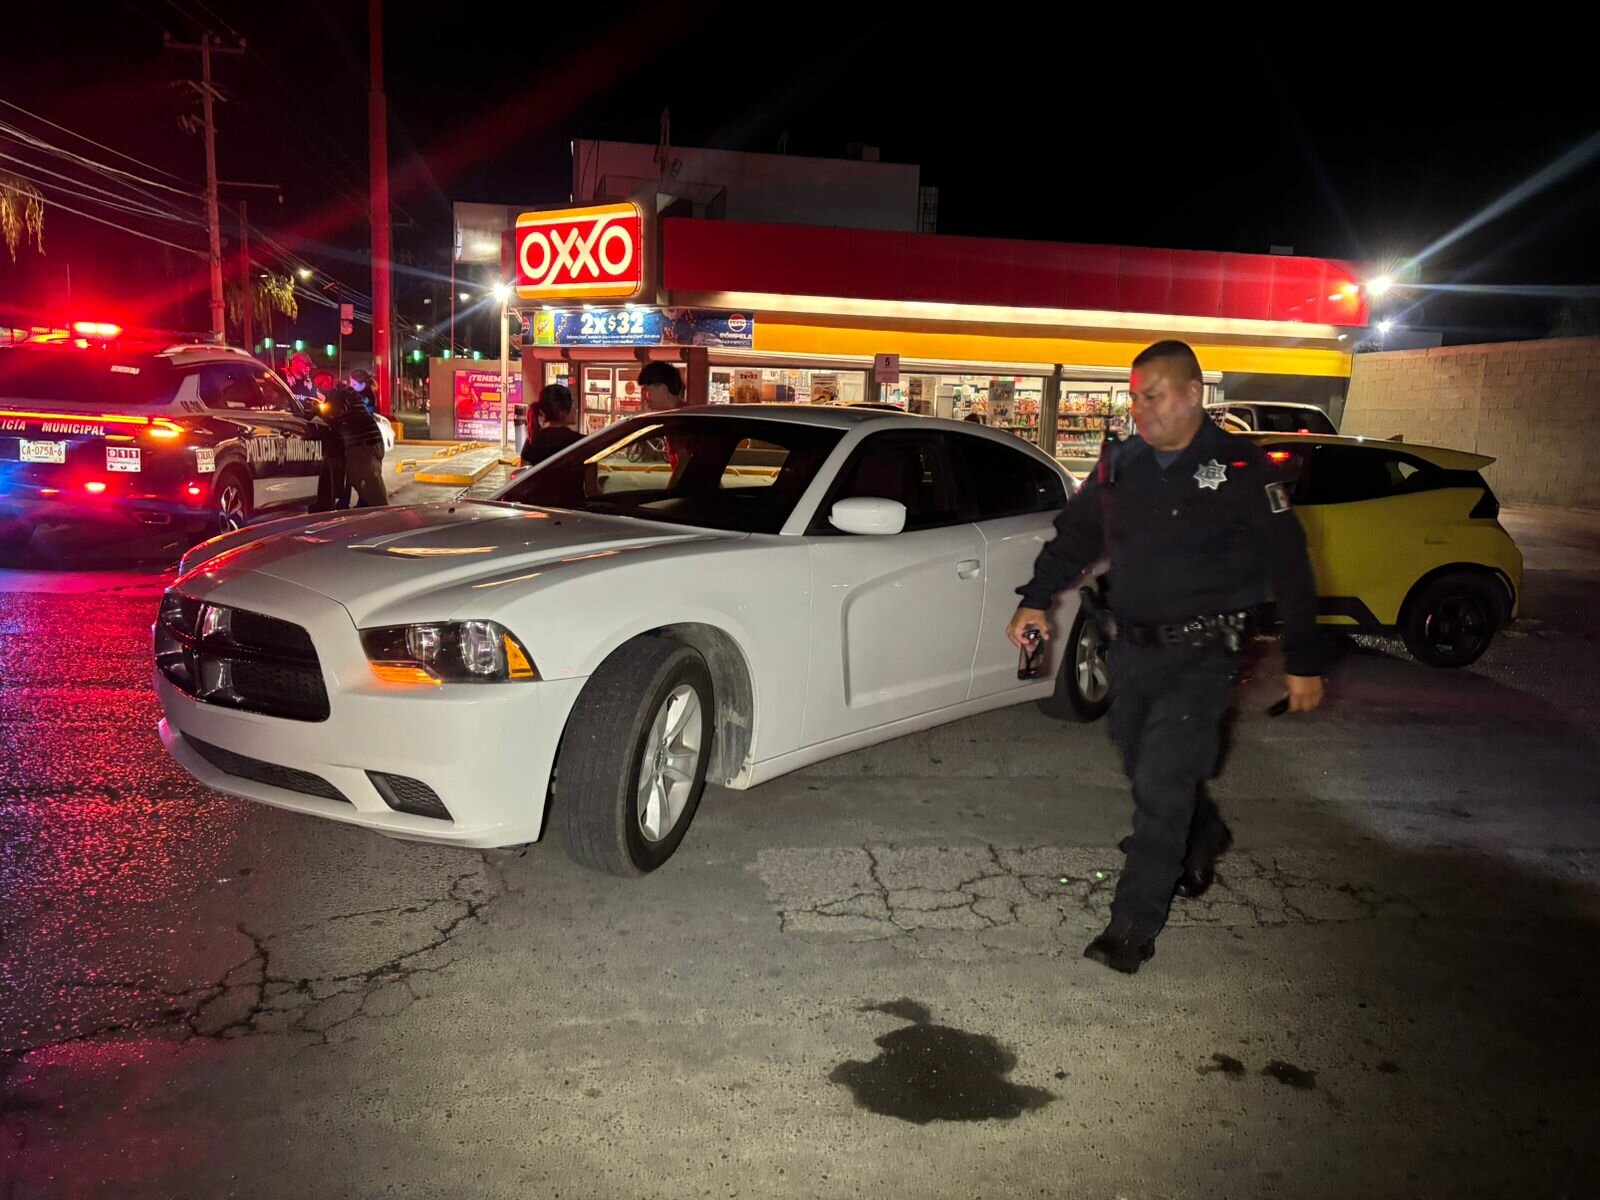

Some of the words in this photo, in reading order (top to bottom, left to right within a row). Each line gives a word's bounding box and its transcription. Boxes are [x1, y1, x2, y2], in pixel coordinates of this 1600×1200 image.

[519, 218, 634, 284] OXXO
[885, 357, 891, 367] 5
[469, 374, 514, 384] ¡TENEMS
[1, 418, 26, 431] ICÍA
[41, 421, 106, 436] MUNICIPAL
[21, 444, 63, 457] CA-075A-6
[107, 448, 140, 459] 911
[286, 438, 323, 461] MUNICIPAL
